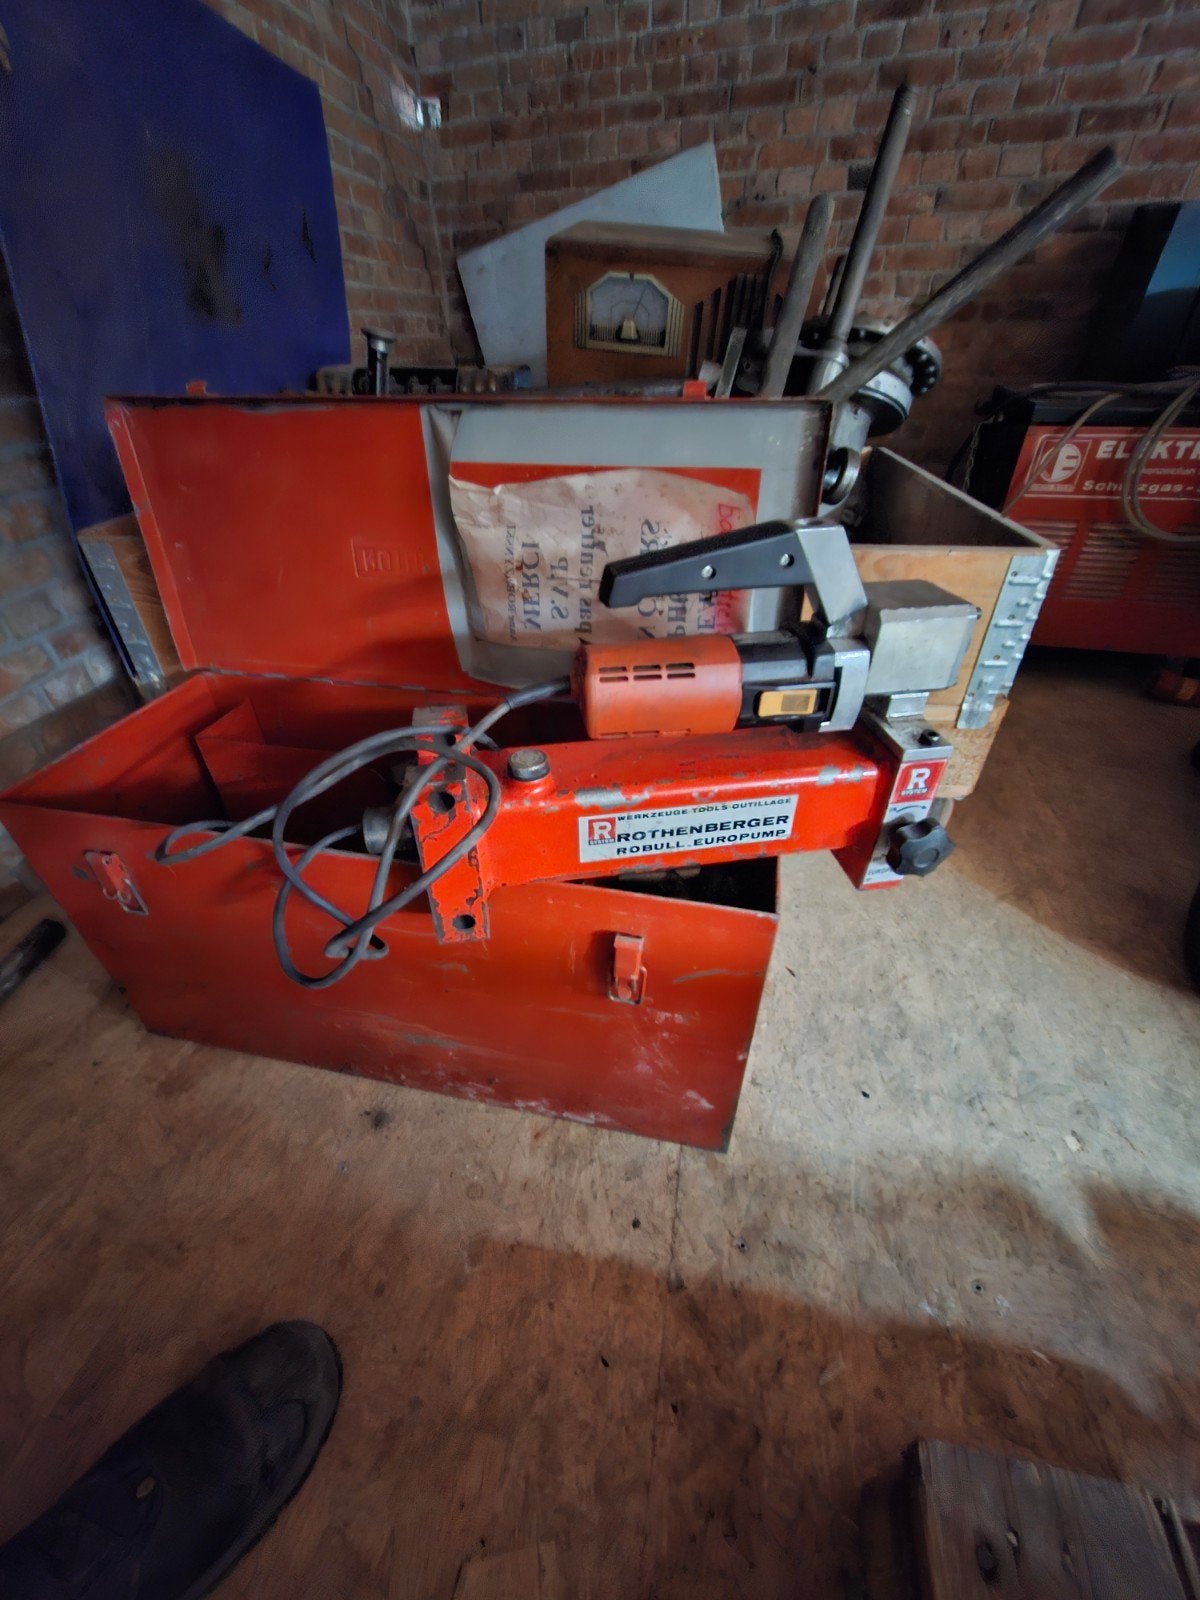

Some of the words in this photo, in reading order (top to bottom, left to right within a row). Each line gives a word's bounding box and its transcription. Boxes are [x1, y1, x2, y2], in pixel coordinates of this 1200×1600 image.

[1095, 440, 1200, 459] ELKT
[905, 767, 931, 790] R
[617, 808, 688, 821] WERKZEUGE
[692, 804, 728, 814] TOOLS
[732, 798, 792, 809] OUTILLAGE
[592, 821, 612, 841] R
[616, 815, 790, 843] ROTHENBERGER
[693, 829, 786, 846] EUROPUMP
